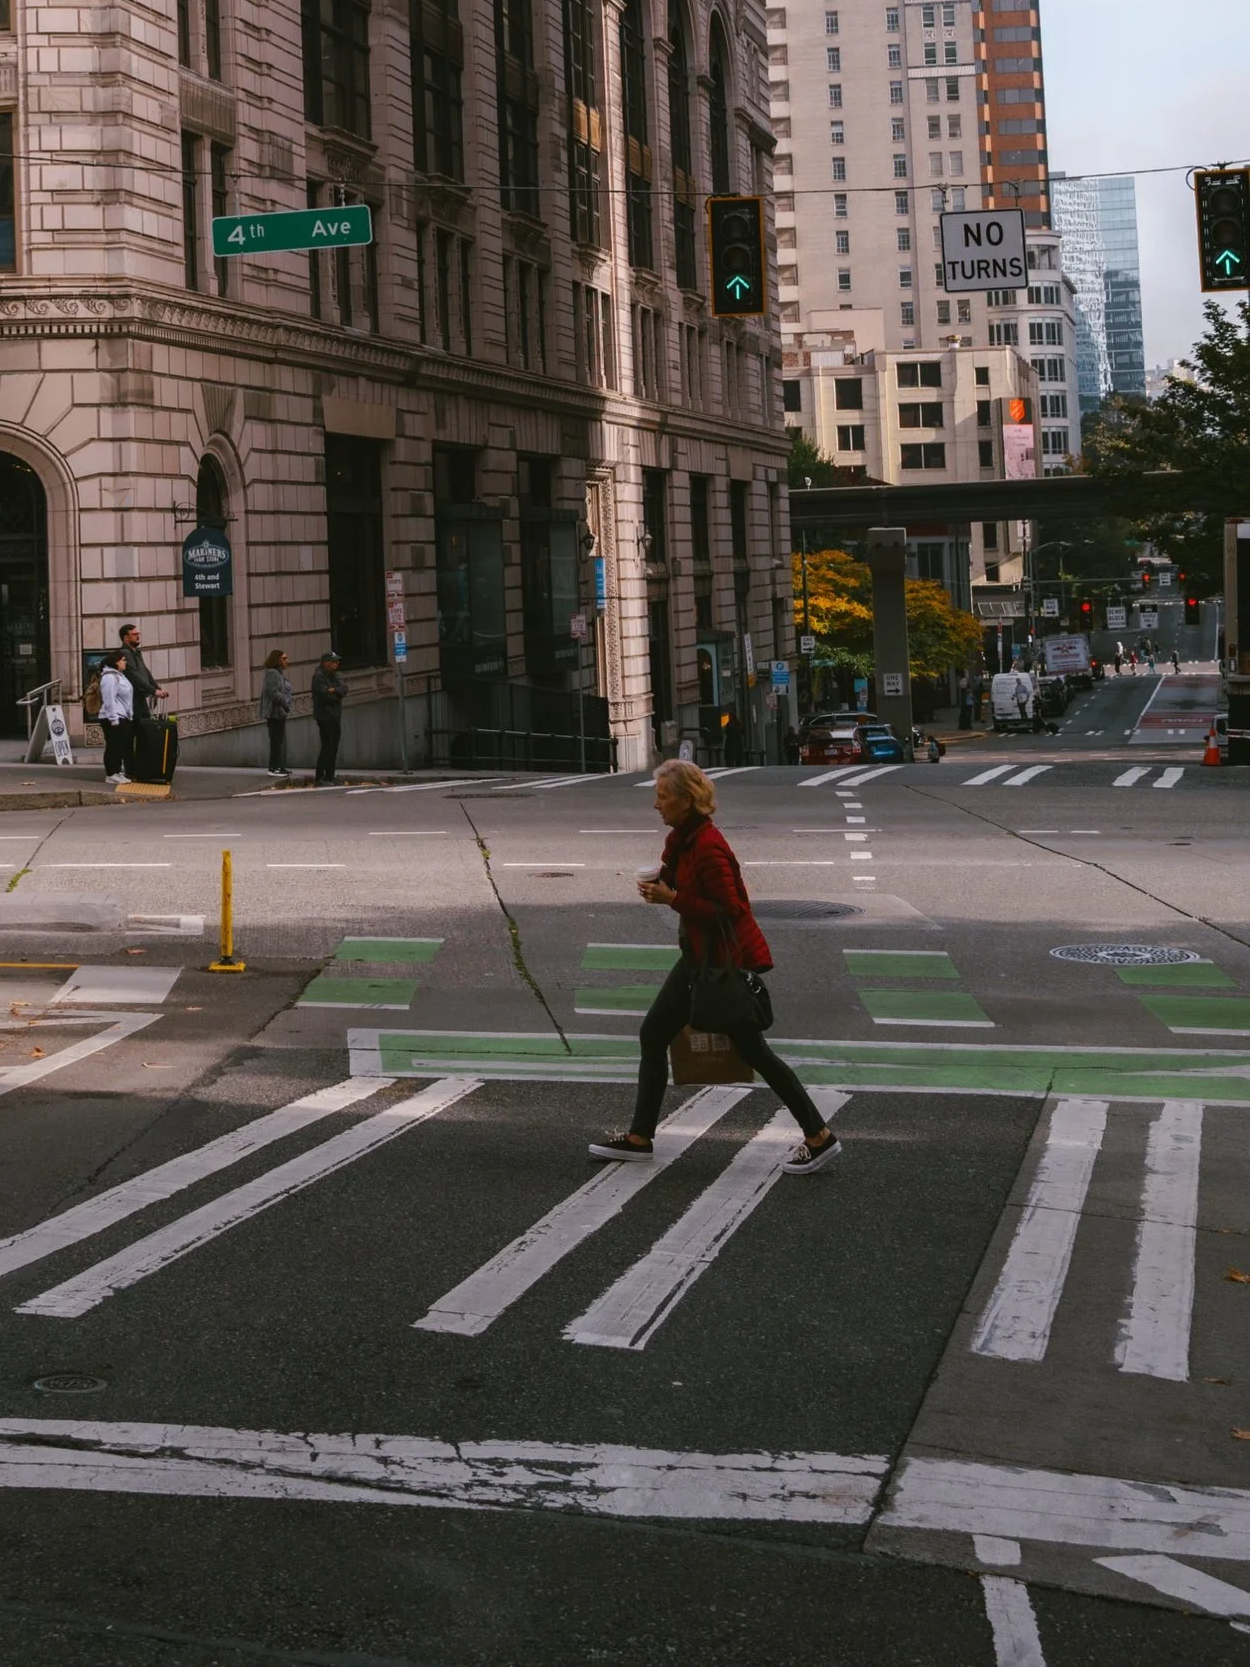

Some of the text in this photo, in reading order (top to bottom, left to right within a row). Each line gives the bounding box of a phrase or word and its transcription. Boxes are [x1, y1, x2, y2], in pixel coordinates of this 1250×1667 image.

[227, 220, 351, 246] 4th Ave
[963, 221, 1004, 248] NO
[947, 257, 1023, 281] TURNS
[188, 547, 226, 561] MARINERS
[194, 572, 220, 581] 4th and
[194, 582, 221, 590] Stewart
